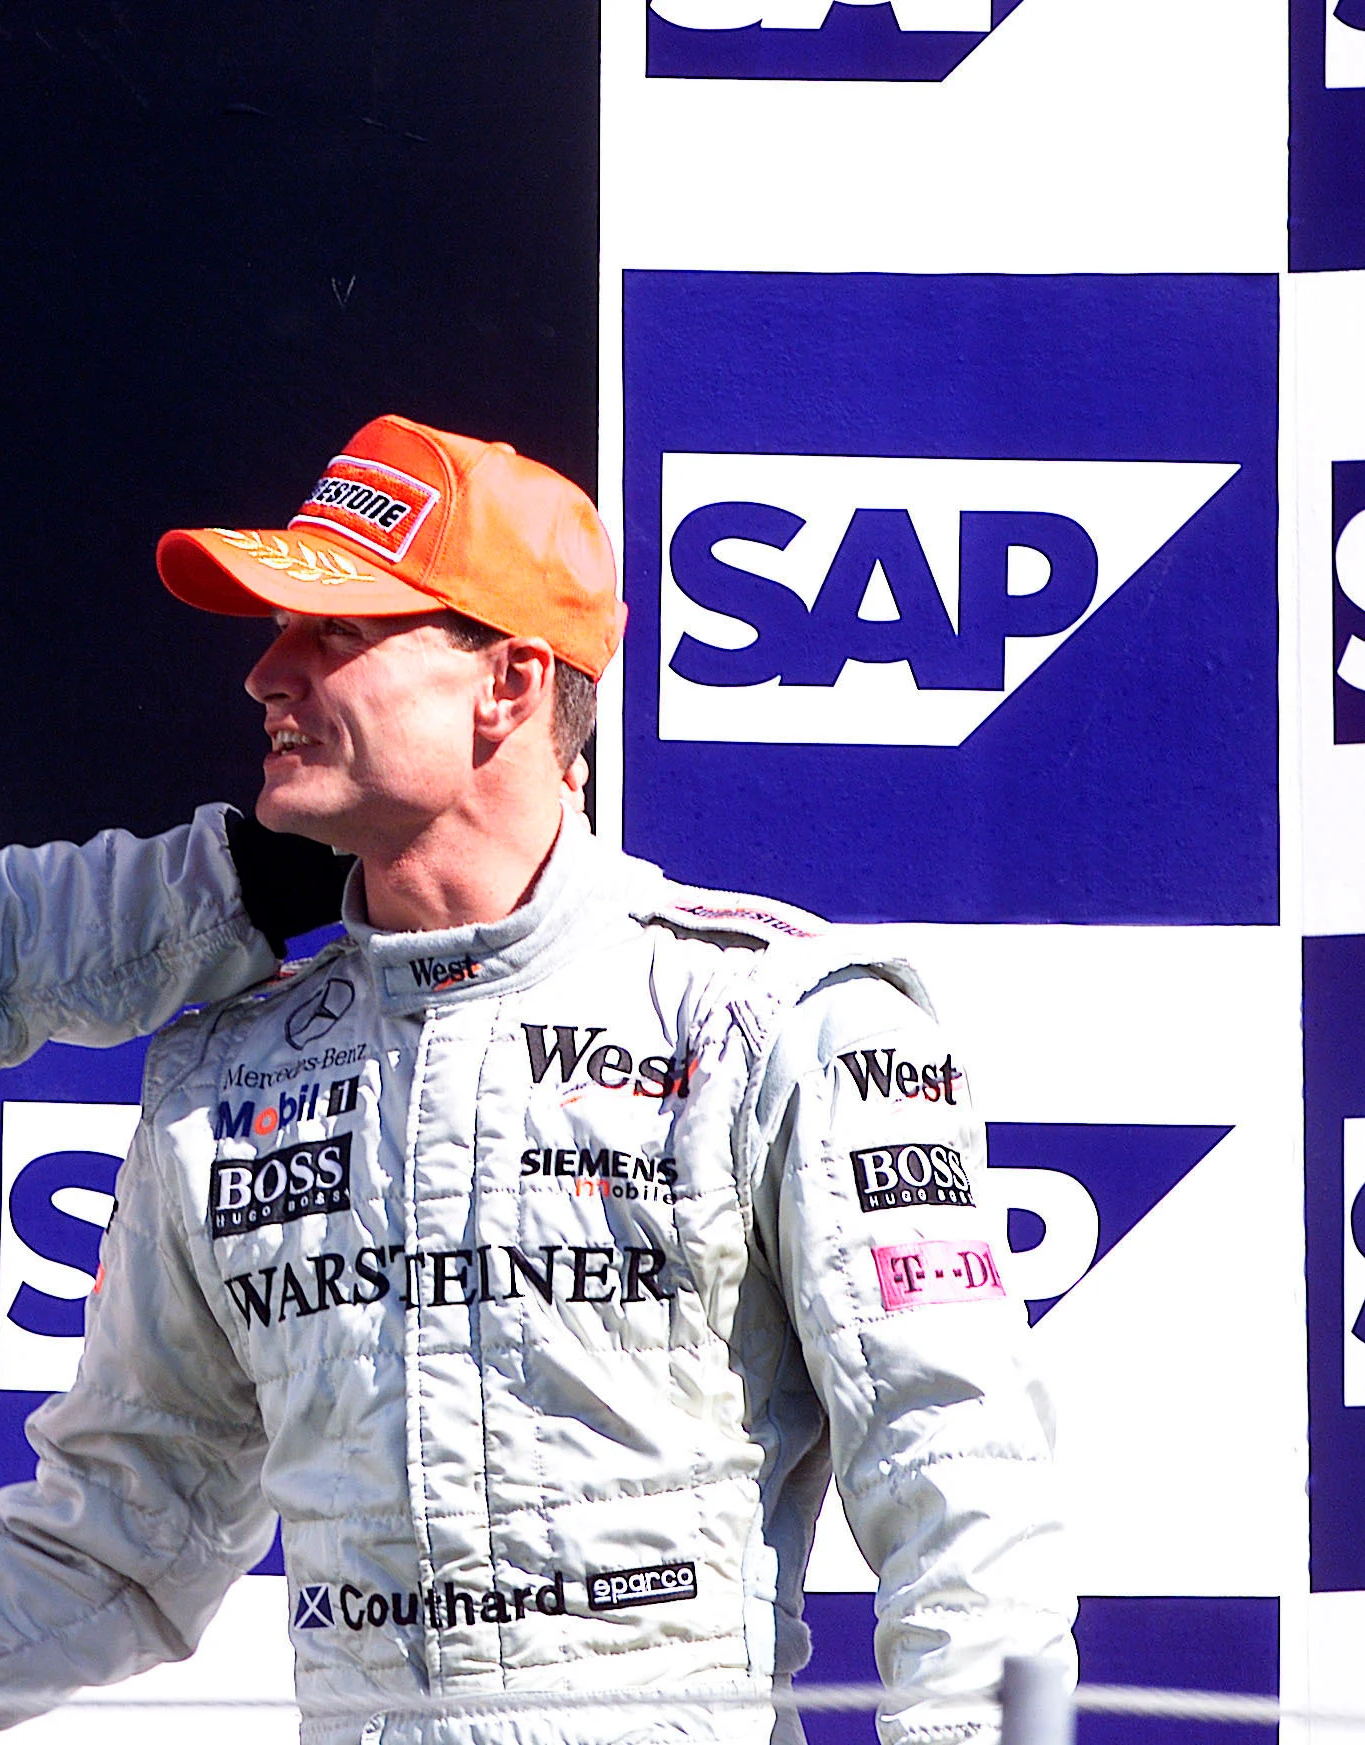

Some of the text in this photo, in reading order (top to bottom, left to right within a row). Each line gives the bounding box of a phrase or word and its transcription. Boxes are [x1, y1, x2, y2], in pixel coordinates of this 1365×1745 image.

[312, 478, 407, 528] ESTONE
[667, 500, 1099, 692] SAP
[409, 954, 483, 989] West
[223, 1043, 368, 1090] Mercedes-Benz
[836, 1047, 963, 1106] West
[213, 1083, 321, 1141] Mobil
[215, 1146, 345, 1212] BOSS
[520, 1147, 679, 1186] SIEMENS
[574, 1177, 678, 1206] mobile
[856, 1144, 971, 1195] BOSS
[215, 1204, 272, 1228] HUGO
[225, 1244, 678, 1331] WARSTEINER
[591, 1566, 696, 1606] sparco
